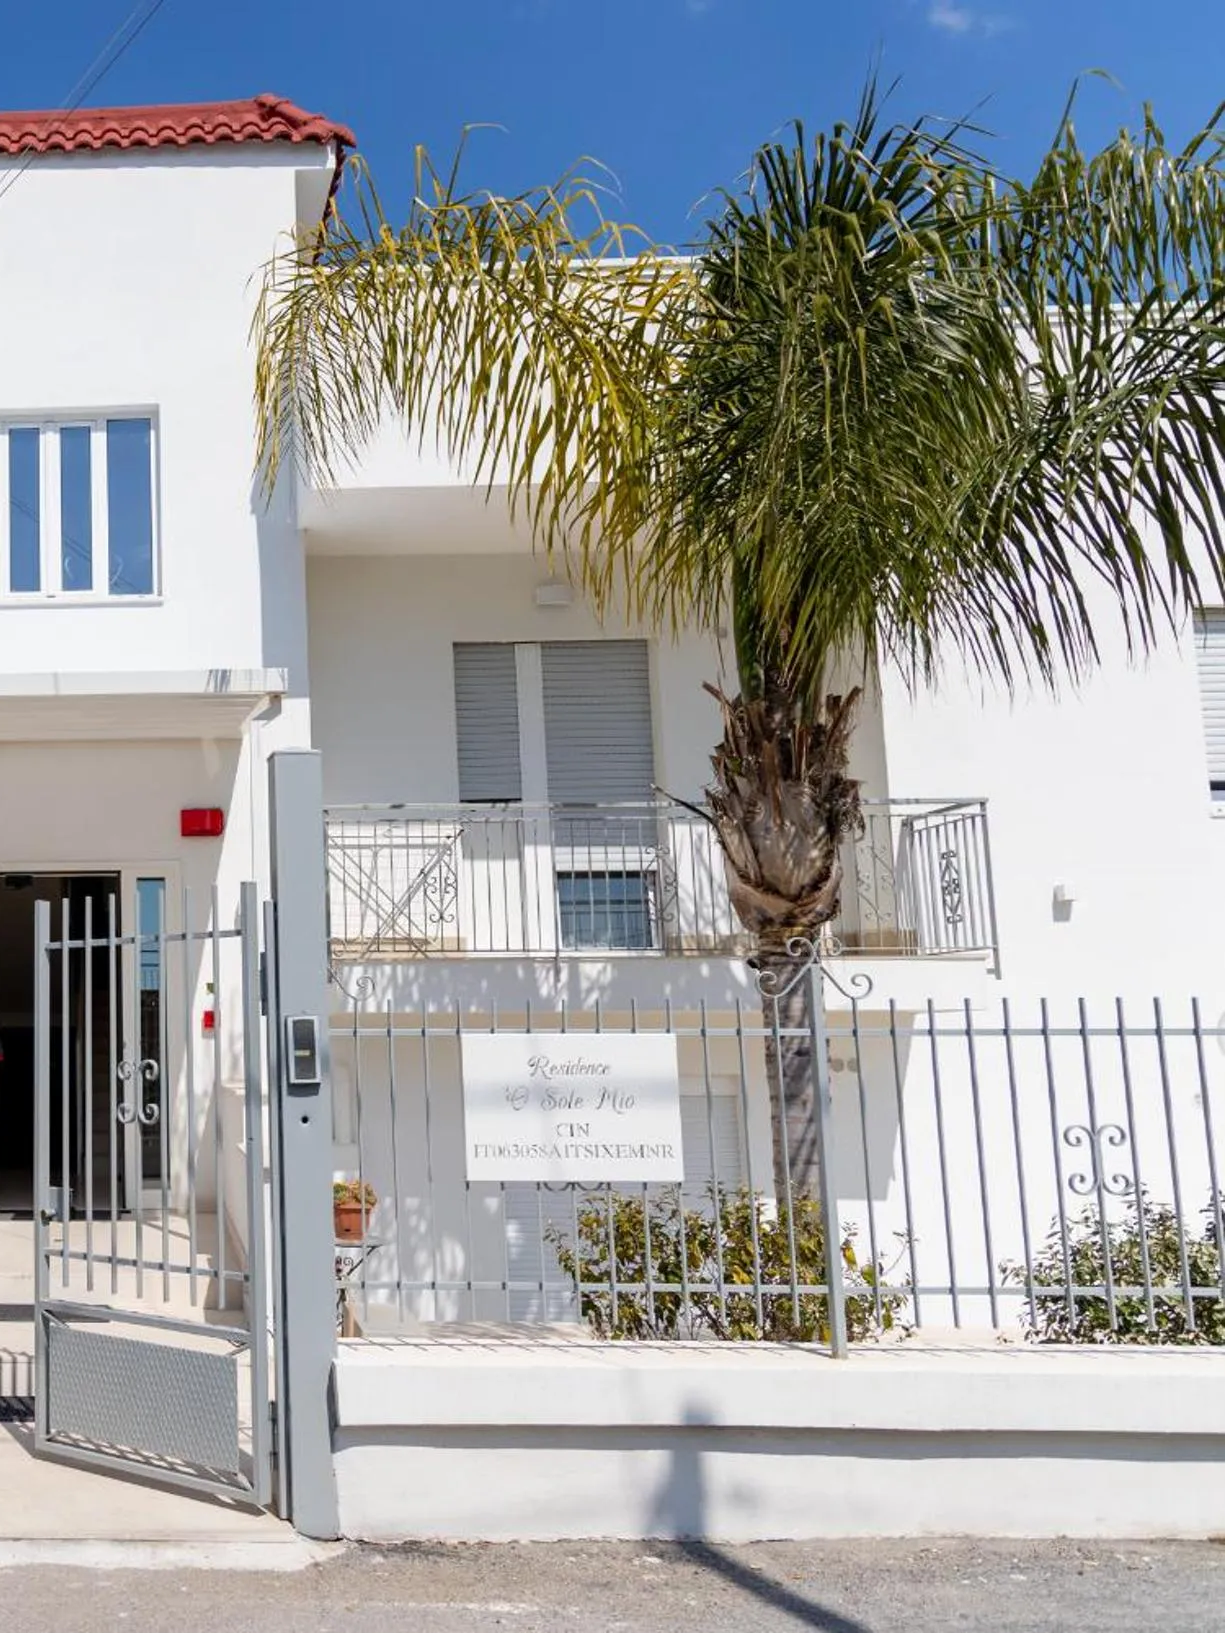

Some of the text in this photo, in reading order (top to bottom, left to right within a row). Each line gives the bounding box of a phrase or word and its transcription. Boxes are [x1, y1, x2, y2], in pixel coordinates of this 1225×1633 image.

[527, 1056, 612, 1080] Residence
[540, 1088, 585, 1112] Sole
[596, 1086, 636, 1115] Mio
[555, 1122, 591, 1138] CIN
